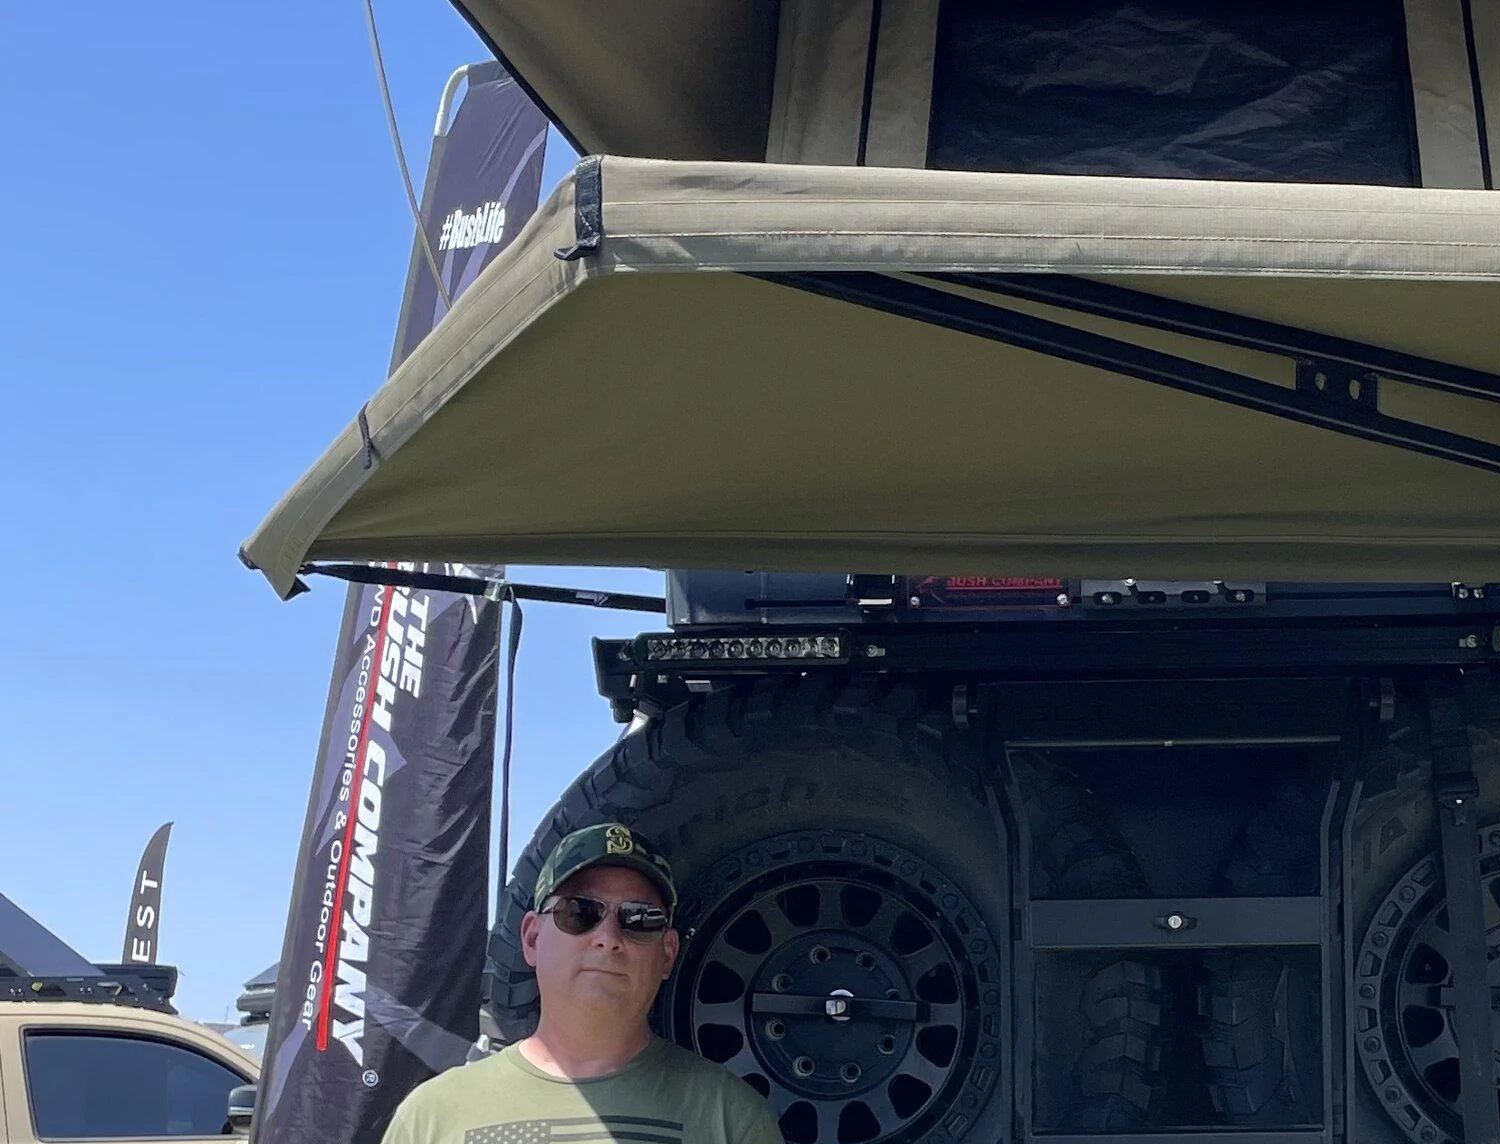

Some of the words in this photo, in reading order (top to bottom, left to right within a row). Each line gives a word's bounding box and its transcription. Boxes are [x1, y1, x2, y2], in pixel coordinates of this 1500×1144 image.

[439, 201, 506, 251] #BushLife
[399, 594, 430, 698] THE
[339, 633, 376, 802] Accessories
[334, 810, 347, 830] &
[131, 870, 158, 963] EST
[315, 839, 343, 954] Outdoor
[332, 739, 386, 1067] COMPANY
[301, 960, 323, 1031] Gear
